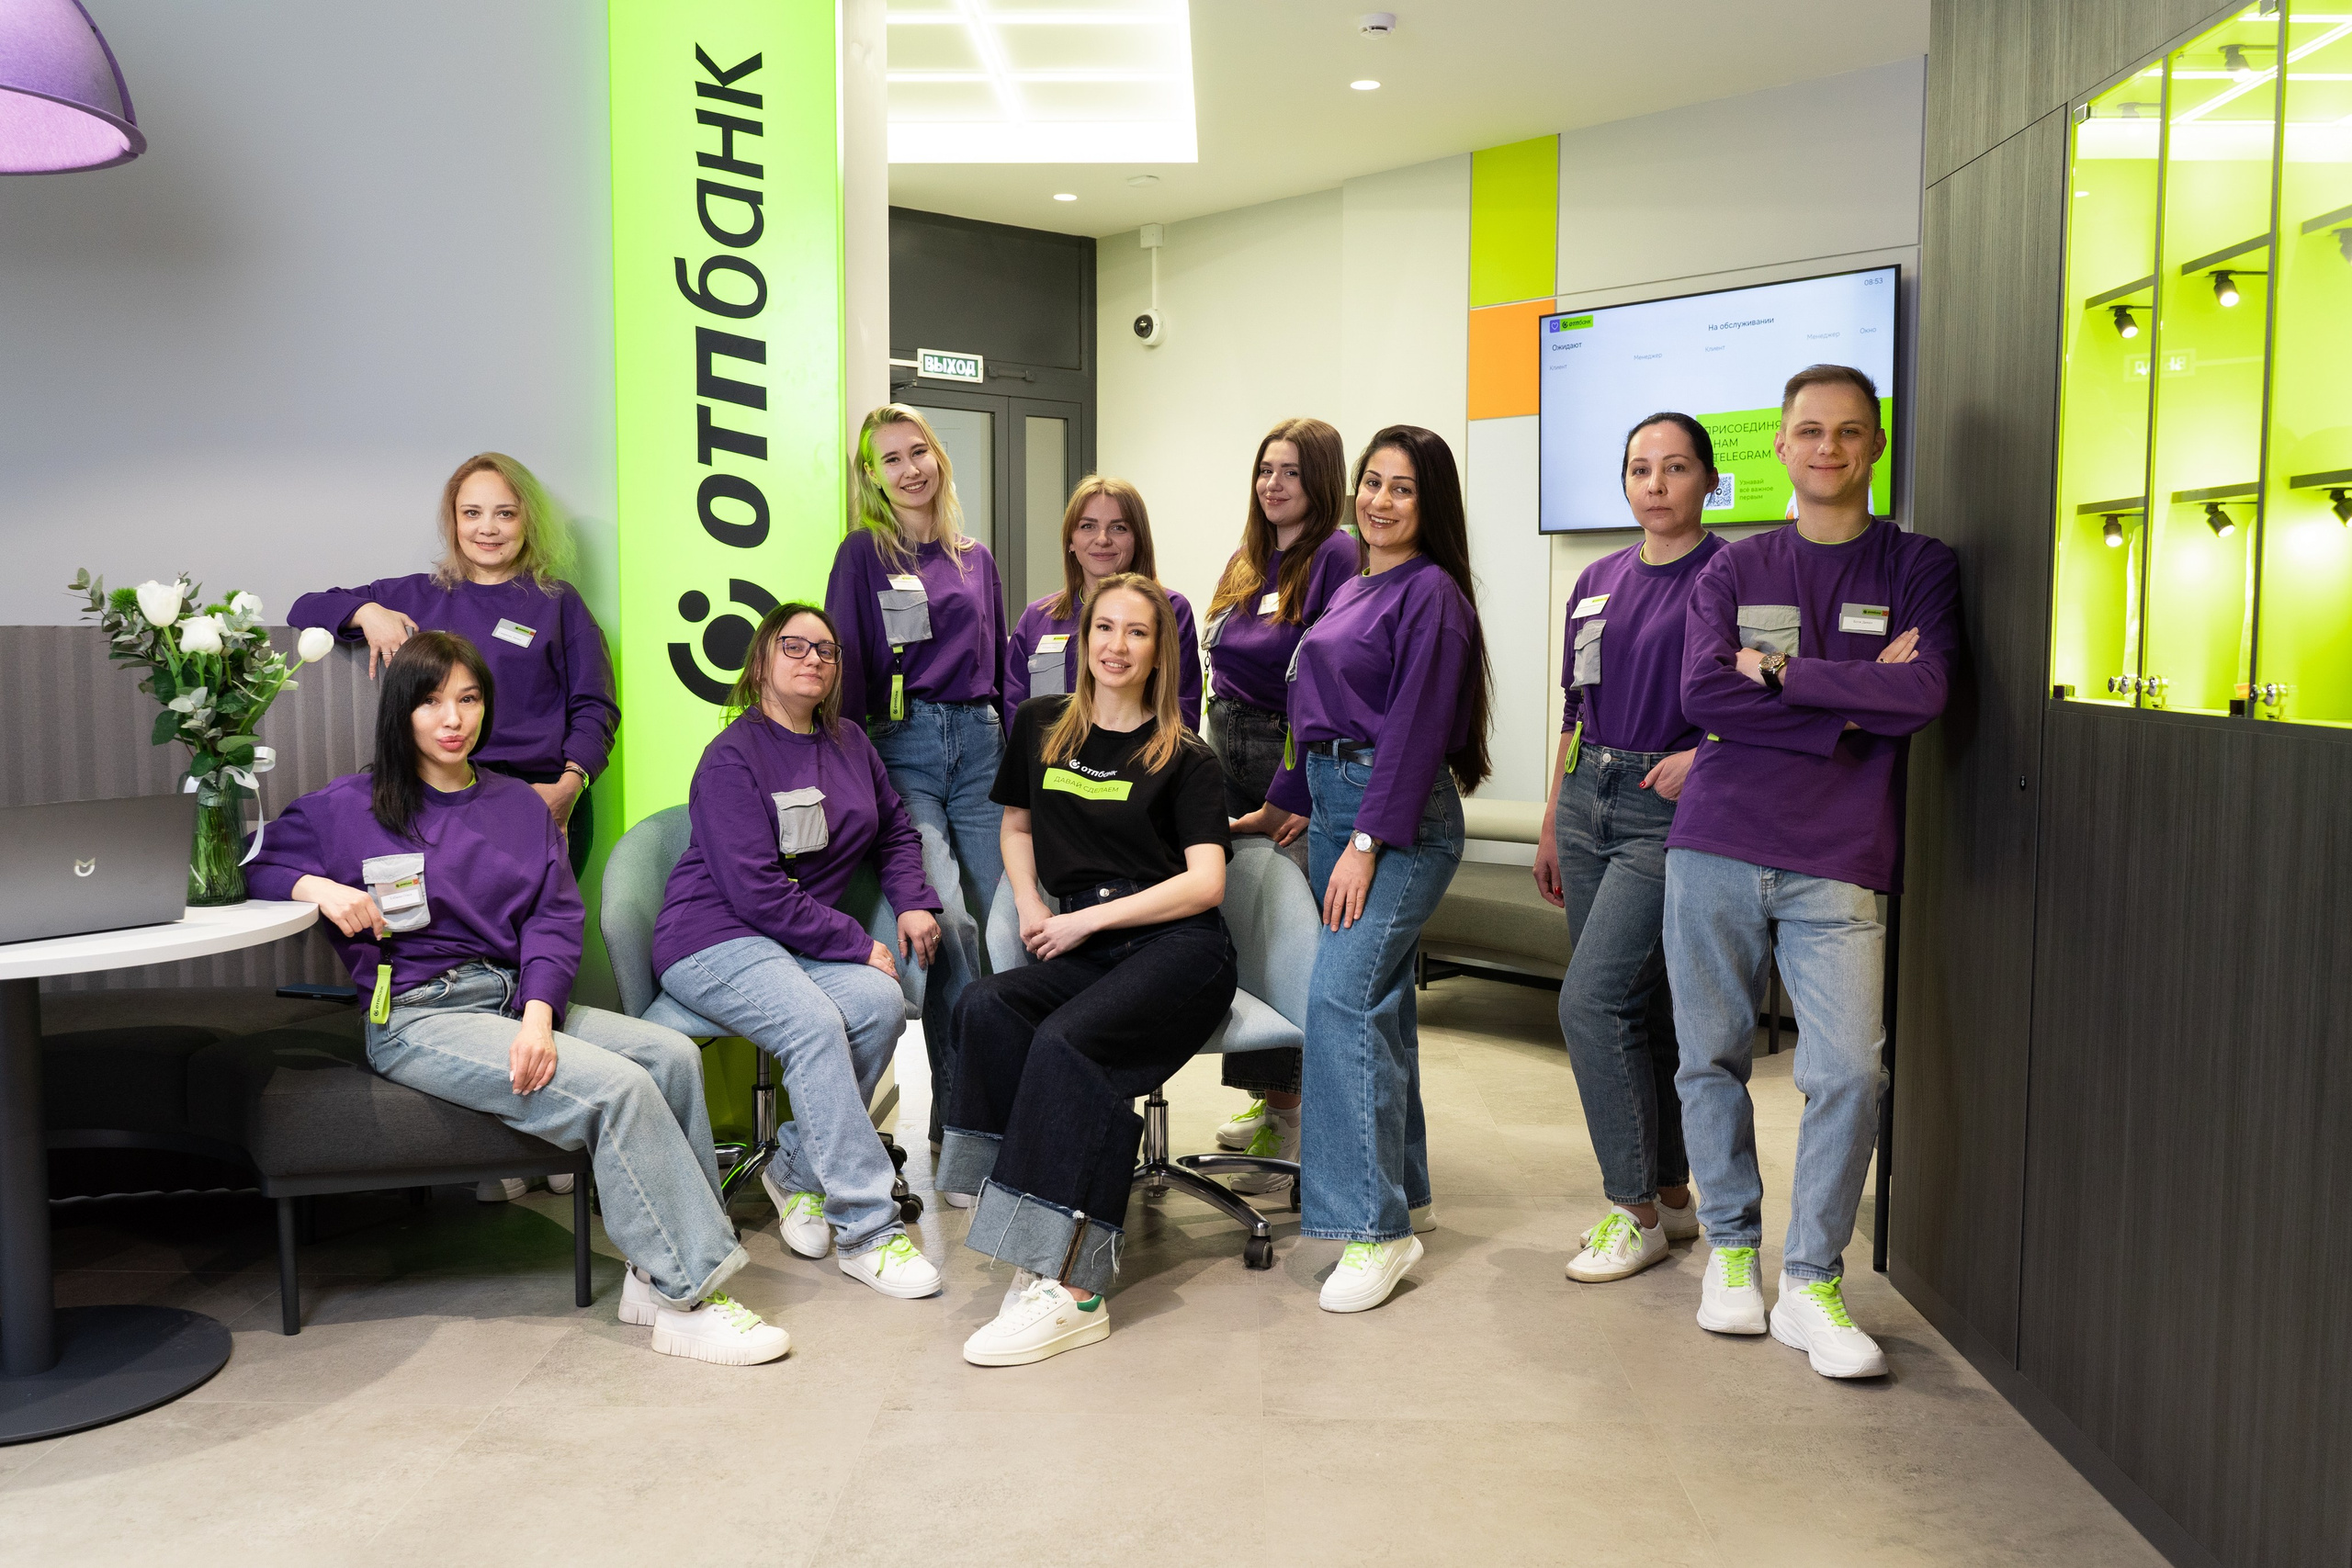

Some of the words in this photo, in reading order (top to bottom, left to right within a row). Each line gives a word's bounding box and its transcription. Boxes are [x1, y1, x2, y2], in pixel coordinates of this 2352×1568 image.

[1863, 277, 1883, 286] 08:53
[673, 41, 770, 548] отпбанк
[1568, 319, 1591, 327] отпбанк
[1708, 323, 1718, 332] На
[1720, 317, 1774, 330] обслуживании
[1860, 326, 1877, 334] Окно
[1806, 331, 1840, 340] Менеджер
[1552, 342, 1582, 351] Ожидают
[1634, 353, 1663, 361] Менеджер
[924, 355, 976, 377] ВЫХОД
[1713, 438, 1738, 448] НАМ
[1713, 449, 1771, 462] TELEGRAM
[1080, 765, 1118, 778] отпбанк
[1054, 775, 1082, 789] ДАВАЙ
[1083, 785, 1119, 794] СДЕЛАЕМ
